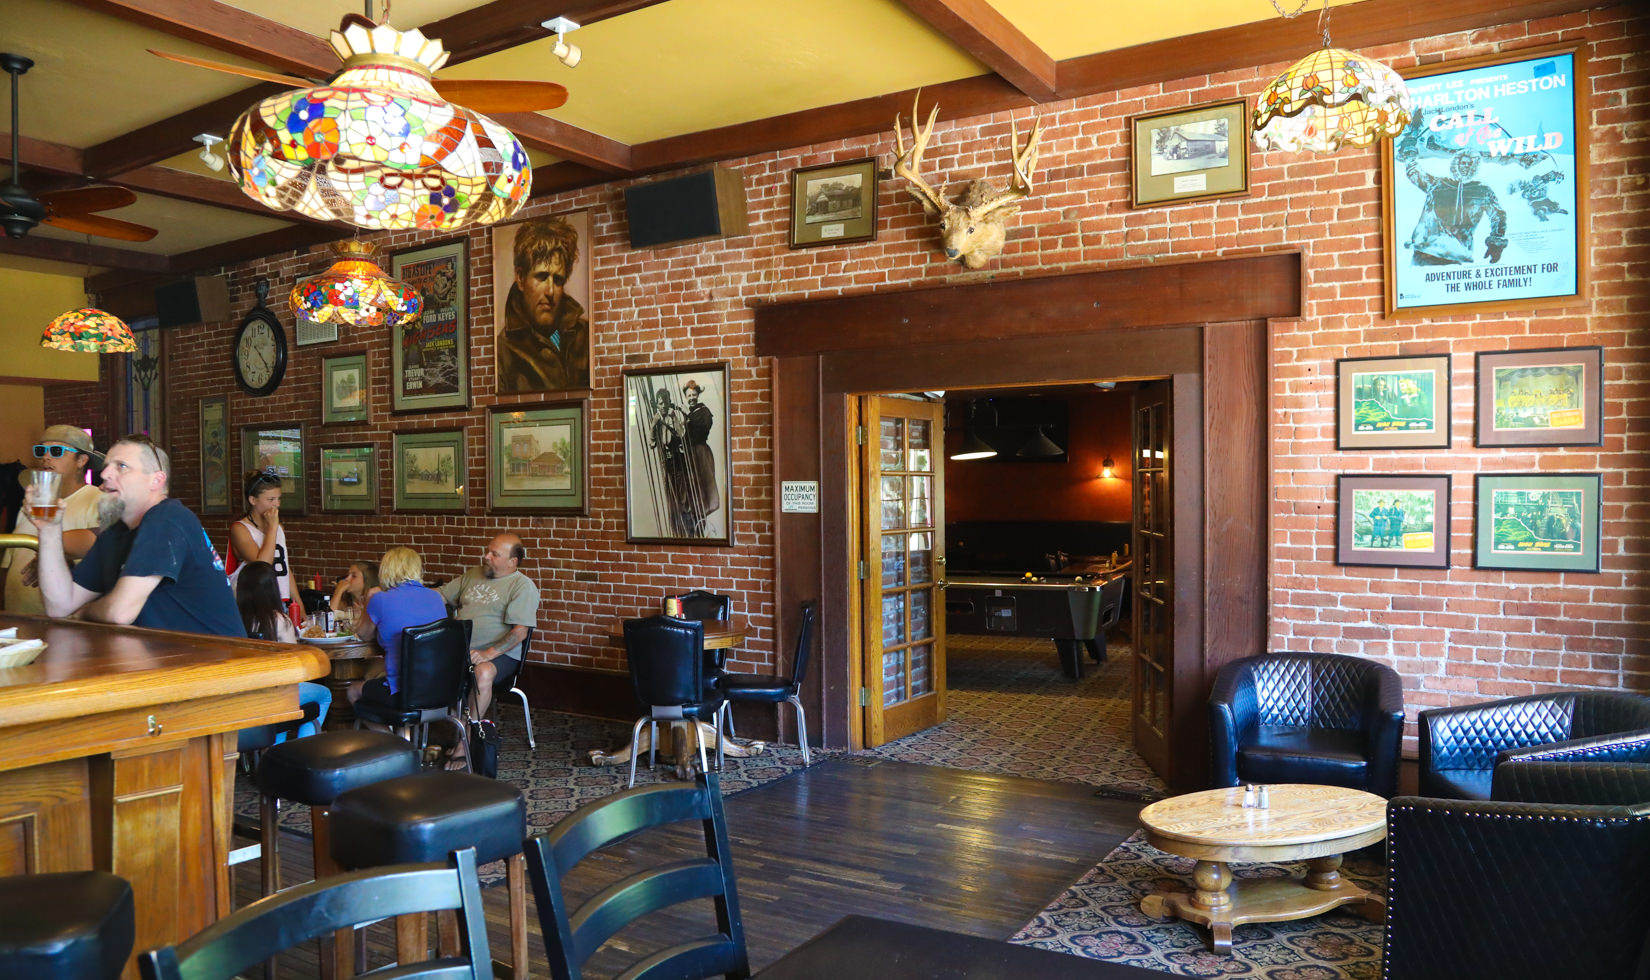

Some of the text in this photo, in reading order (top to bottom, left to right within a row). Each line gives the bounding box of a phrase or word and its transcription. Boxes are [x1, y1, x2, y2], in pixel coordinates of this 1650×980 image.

[1446, 80, 1464, 89] LEE
[1470, 74, 1509, 85] PRESENTS
[1409, 74, 1566, 110] HARLTON HESTON
[1422, 103, 1475, 116] Jack London's
[1429, 107, 1500, 132] CALL
[1486, 132, 1564, 157] WILD
[1425, 263, 1559, 282] ADVENTURE & EXCITEMENT FOR
[1445, 277, 1532, 293] THE WHOLE FAMILY!
[423, 314, 437, 323] FORD
[438, 311, 456, 321] KEYES
[251, 327, 256, 338] 11
[257, 324, 265, 335] 12
[245, 336, 252, 348] 10
[405, 367, 424, 378] TREVOR
[406, 381, 422, 390] ERWIN
